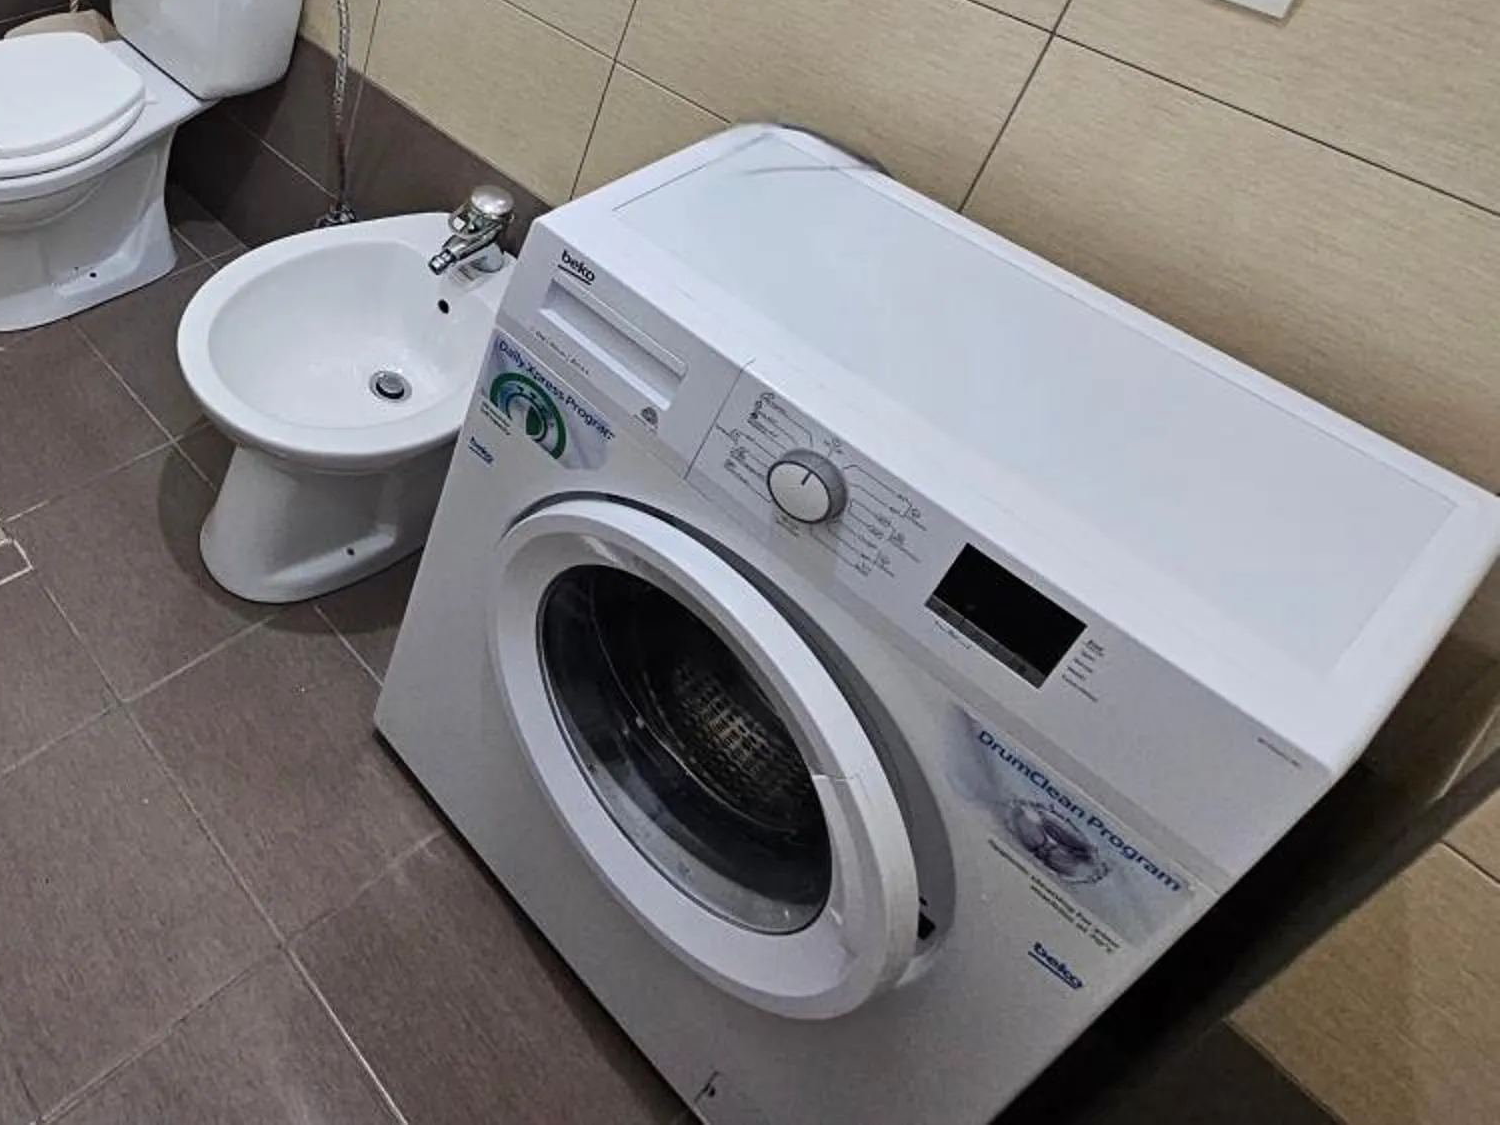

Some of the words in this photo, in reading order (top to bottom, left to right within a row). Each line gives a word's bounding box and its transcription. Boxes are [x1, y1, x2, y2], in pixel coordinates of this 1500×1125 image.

[560, 249, 596, 283] beko
[499, 340, 528, 368] Daily
[524, 363, 566, 403] Xpress
[977, 729, 1086, 819] DrumClean
[1086, 813, 1182, 892] Program
[1033, 941, 1083, 989] beko
